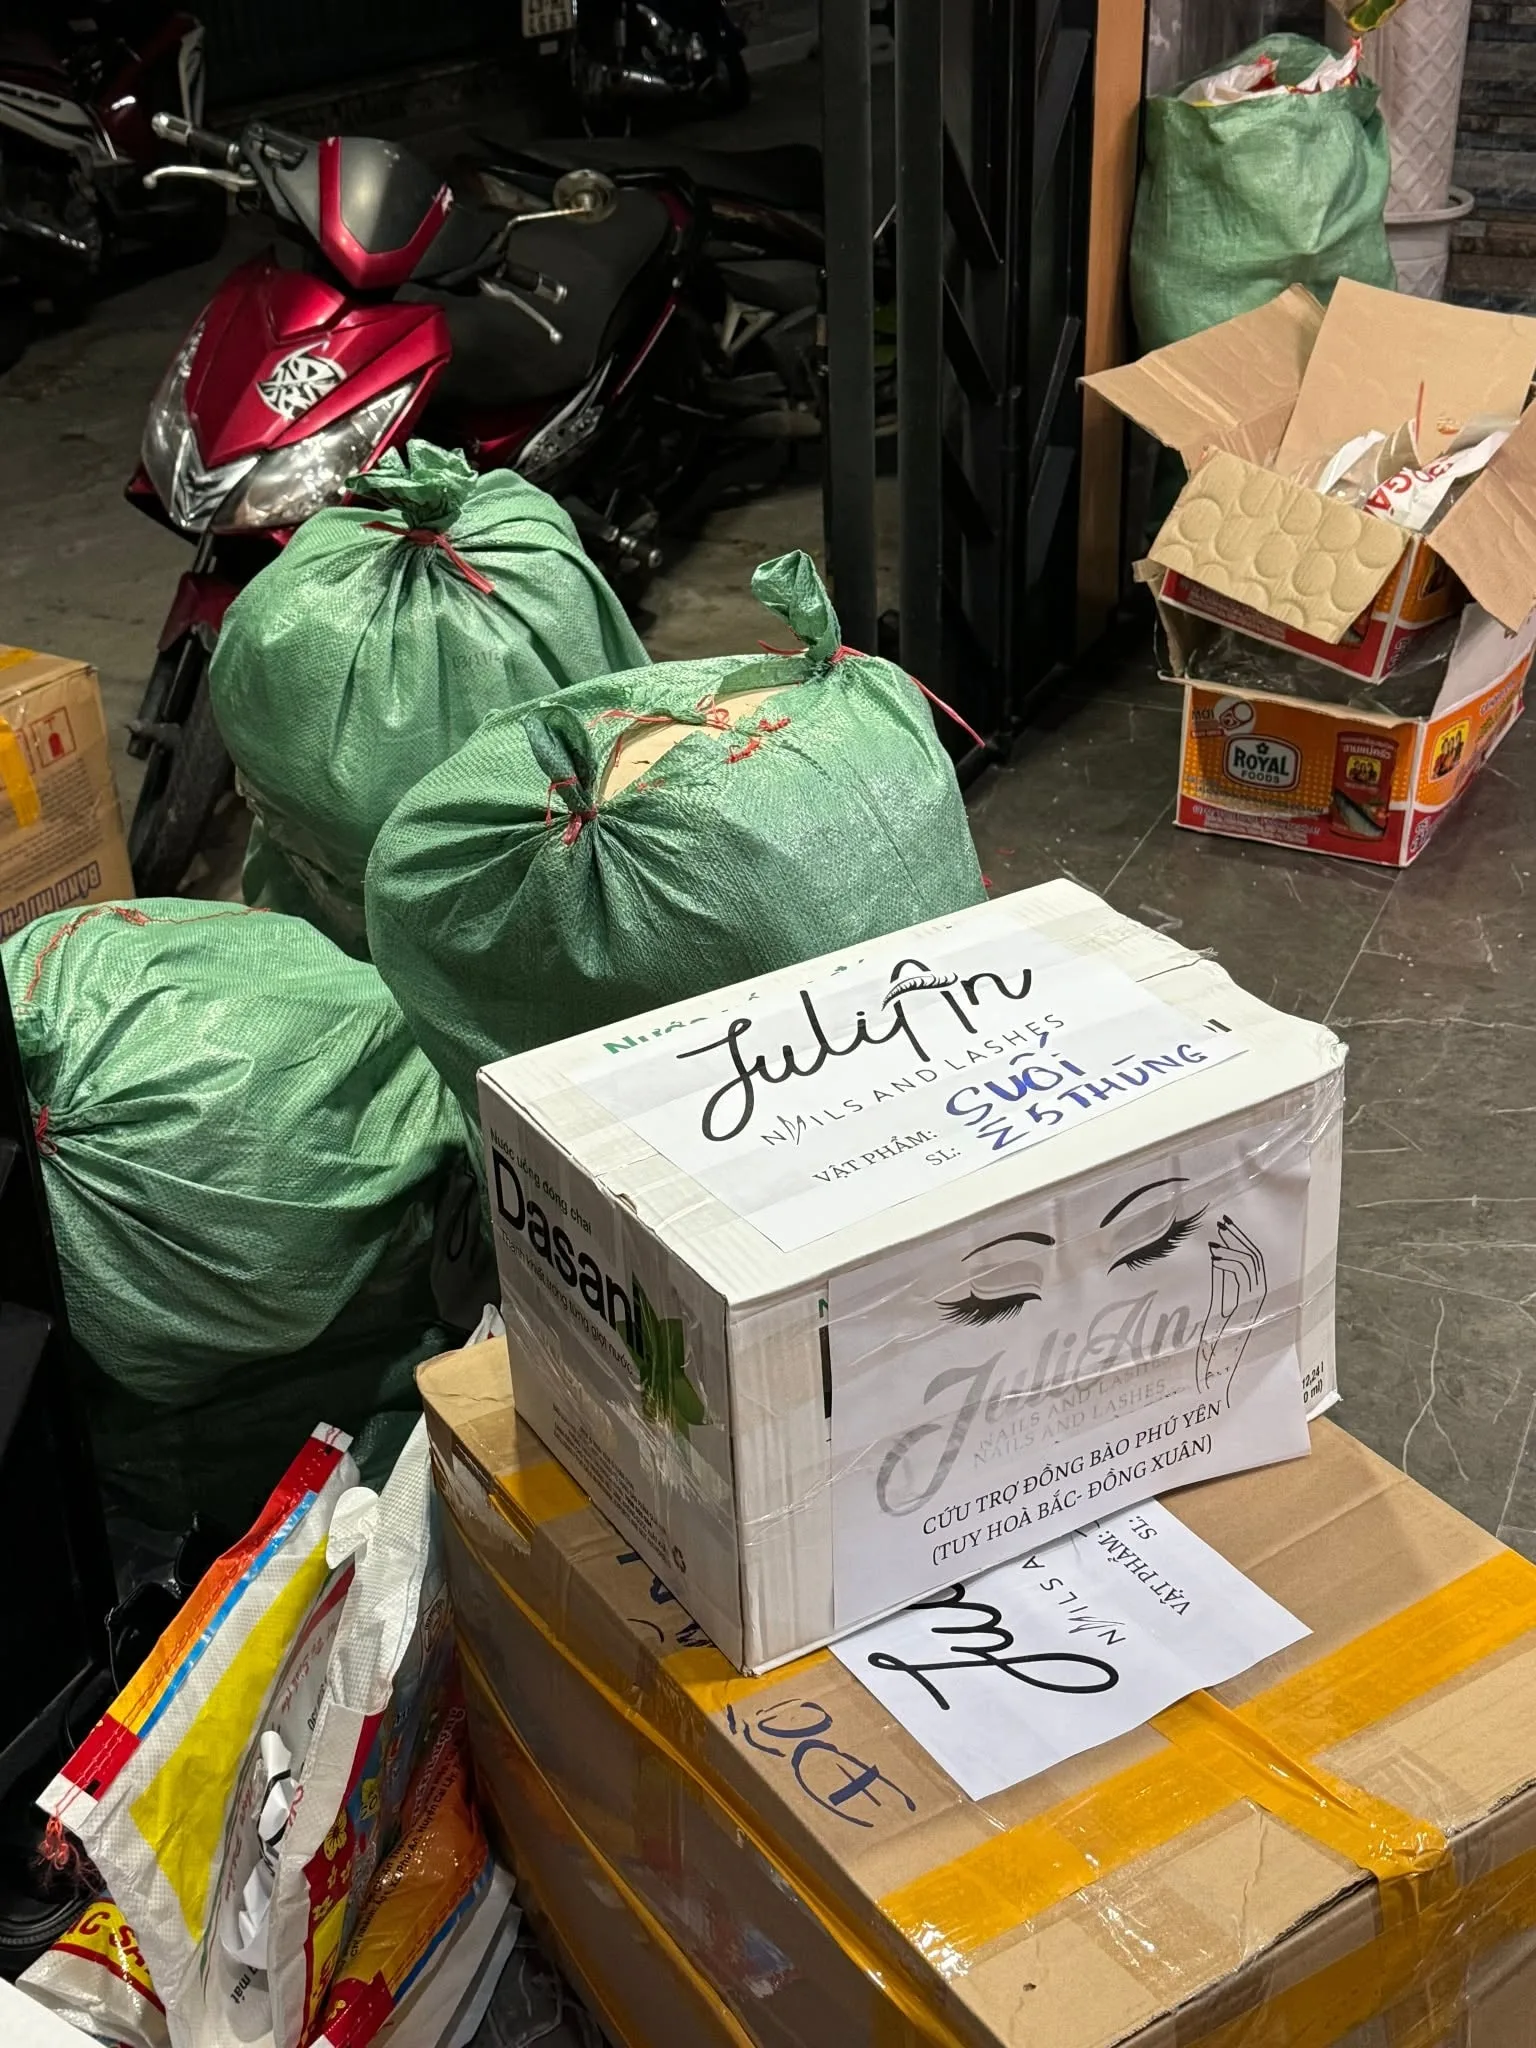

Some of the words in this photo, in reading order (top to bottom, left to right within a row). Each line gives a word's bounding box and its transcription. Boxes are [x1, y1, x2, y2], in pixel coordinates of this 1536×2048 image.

[1233, 747, 1290, 776] ROYAL
[1241, 770, 1280, 784] FOODS
[873, 1069, 938, 1102] AND
[944, 1014, 1065, 1071] LASHES
[812, 1159, 857, 1182] VẬT
[925, 1146, 961, 1167] SL:
[570, 1207, 592, 1236] chai
[491, 1146, 648, 1362] Dasani
[1040, 1414, 1086, 1443] AND
[1091, 1378, 1166, 1421] LASHES
[923, 1503, 971, 1536] CỨU
[975, 1483, 1022, 1517] TRỢ
[1022, 1455, 1086, 1496] ĐỒNG
[1089, 1437, 1131, 1468] BÀO
[1134, 1416, 1179, 1449] PHÚ
[1181, 1400, 1222, 1428] YÊN
[932, 1532, 989, 1566] (TUY
[986, 1506, 1034, 1541] HOÀ
[1037, 1487, 1083, 1520] BẮC-
[1087, 1462, 1148, 1500] ĐỒNG
[1150, 1433, 1213, 1473] XUÂN)
[1128, 1515, 1158, 1540] SL:
[1150, 1581, 1191, 1616] VẬT
